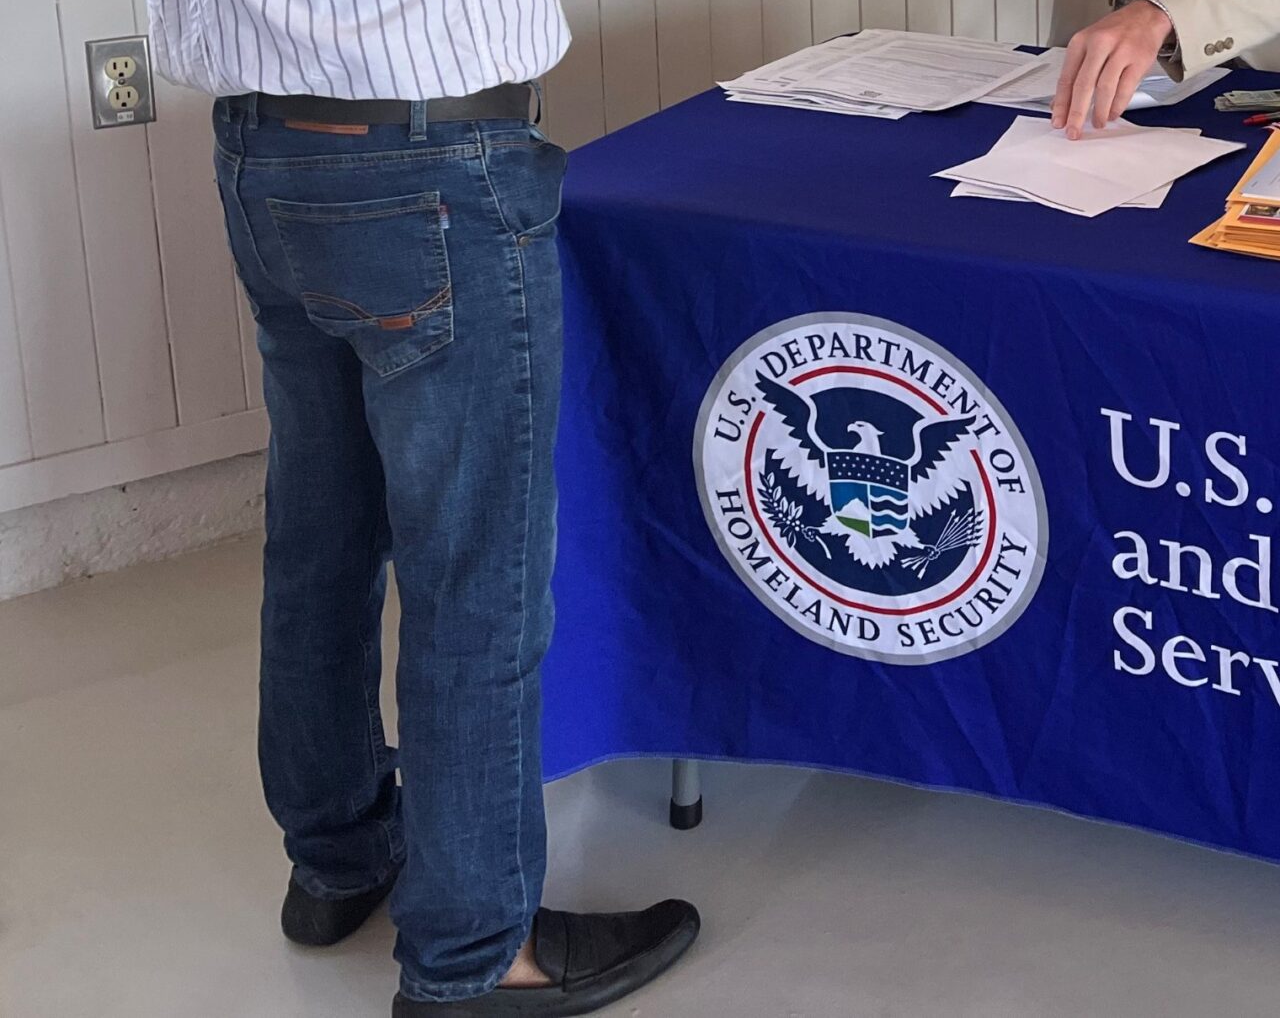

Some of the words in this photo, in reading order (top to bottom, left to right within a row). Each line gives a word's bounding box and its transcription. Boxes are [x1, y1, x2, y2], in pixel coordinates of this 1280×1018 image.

[713, 389, 757, 443] U.S.
[760, 331, 1002, 441] DEPARTMENT
[989, 448, 1026, 496] OF
[1100, 407, 1273, 515] U.S.
[715, 487, 881, 642] HOMELAND
[896, 532, 1028, 648] SECURITY
[1111, 529, 1280, 614] and
